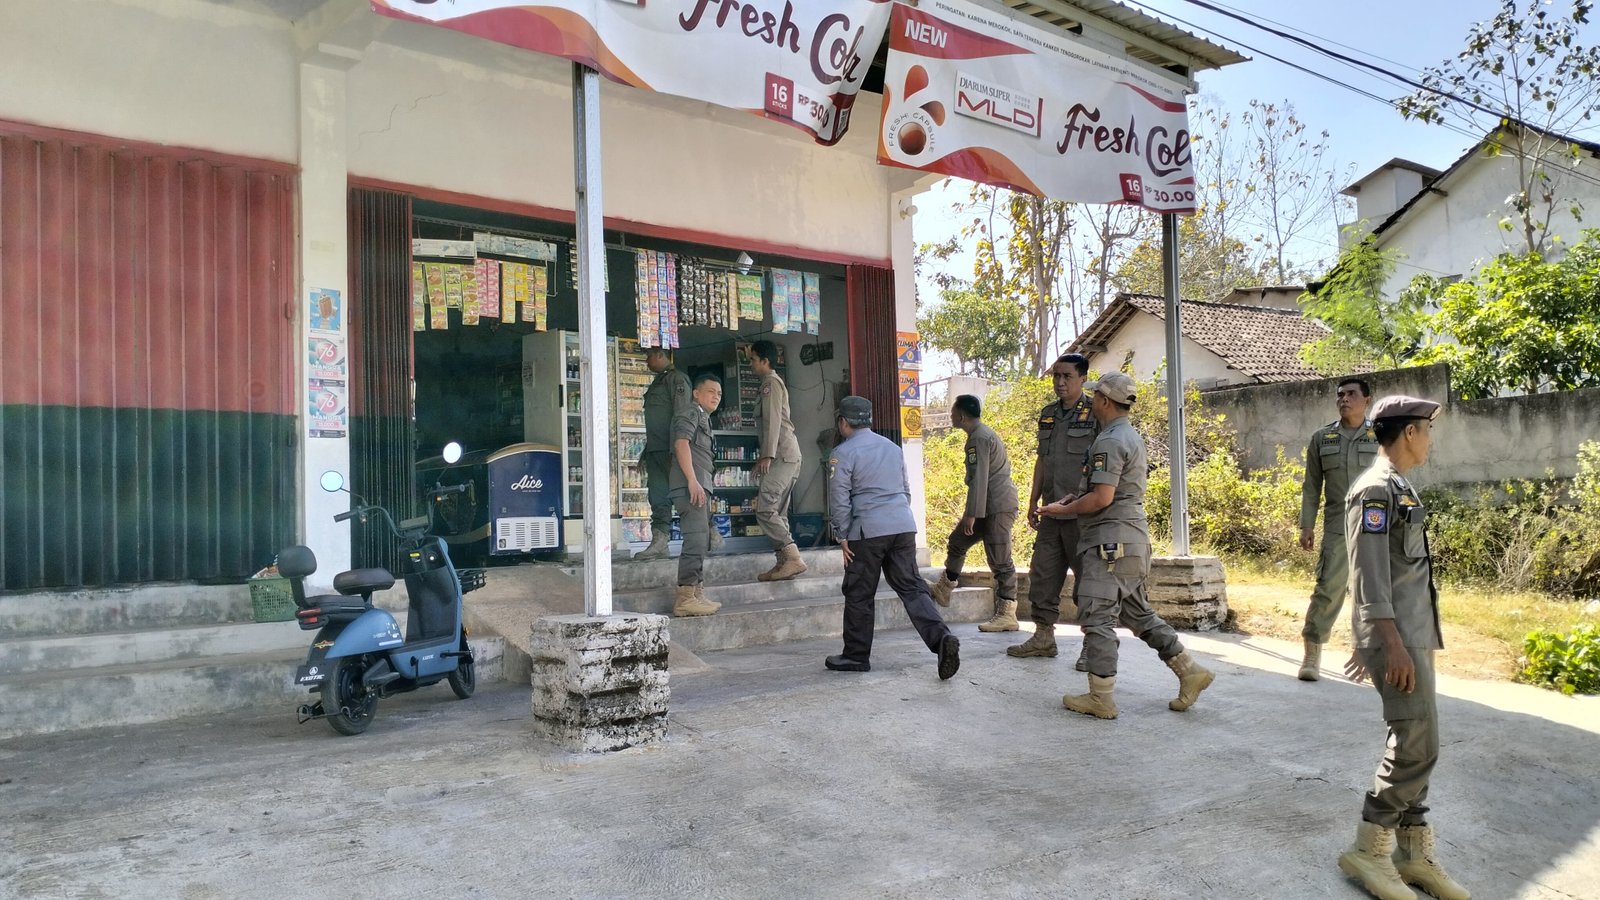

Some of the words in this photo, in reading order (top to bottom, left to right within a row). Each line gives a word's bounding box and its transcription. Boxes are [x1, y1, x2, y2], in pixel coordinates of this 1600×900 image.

[904, 19, 947, 48] NEW
[967, 14, 988, 25] KARENA
[1042, 41, 1060, 52] KANKER
[772, 83, 788, 103] 16
[959, 77, 989, 95] DJARUM
[988, 87, 1011, 102] SUPER
[957, 91, 1035, 128] MLD
[888, 112, 909, 147] FRESH
[912, 112, 936, 153] CAPSULE
[1056, 103, 1141, 157] Fresh
[1126, 179, 1140, 192] 16
[511, 474, 543, 491] Aice
